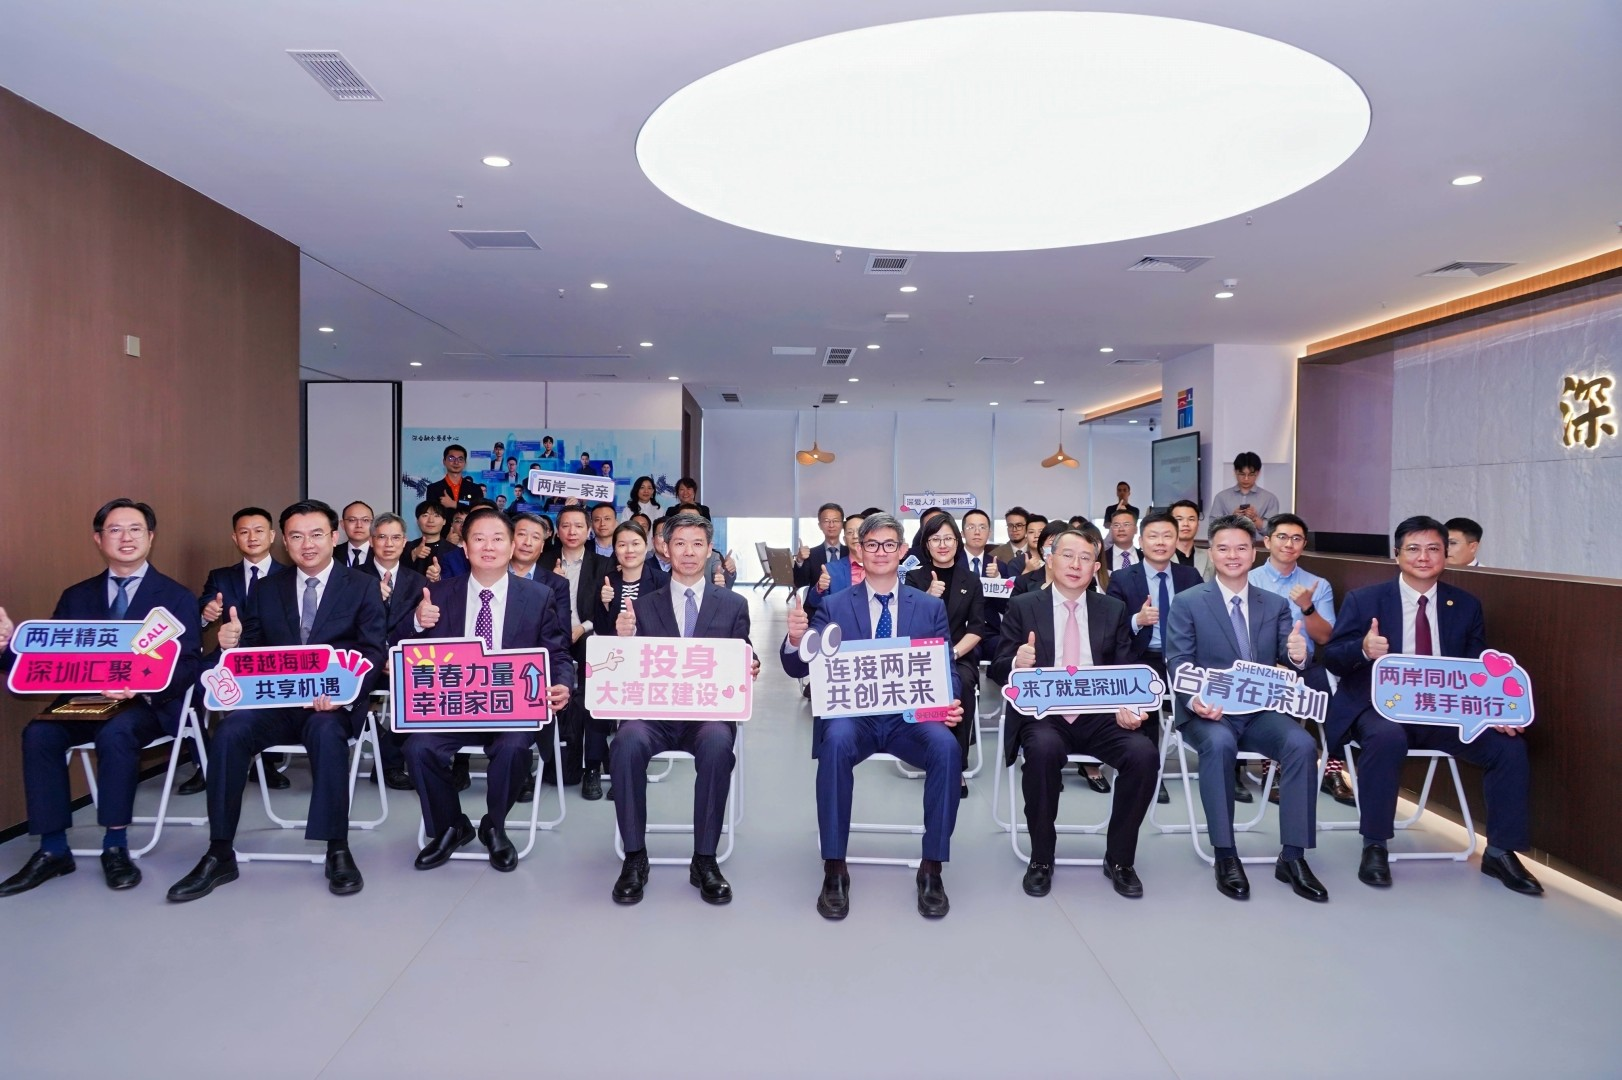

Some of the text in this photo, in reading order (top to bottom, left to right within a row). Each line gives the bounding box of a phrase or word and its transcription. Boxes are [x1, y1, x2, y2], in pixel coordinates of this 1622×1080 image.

[1559, 374, 1616, 447] 深
[538, 478, 609, 498] 两岸一家亲
[25, 627, 119, 648] 两岸精英
[138, 623, 168, 648] CALL
[26, 660, 131, 684] 深圳汇聚
[233, 653, 321, 674] 跨越海峡
[639, 644, 718, 679] 投身
[825, 652, 932, 684] 连接两岸
[1236, 662, 1294, 682] SHENZHEN
[255, 678, 341, 699] 共享机遇
[412, 664, 515, 689] 青春力量
[1022, 678, 1147, 698] 来了就是深圳人
[1379, 665, 1468, 690] 两岸同心
[412, 690, 514, 716] 幸福家园
[596, 681, 719, 707] 大湾区建设
[827, 679, 936, 711] 共创未来
[1175, 665, 1327, 721] 台青在深圳
[1415, 692, 1505, 717] 携手前行
